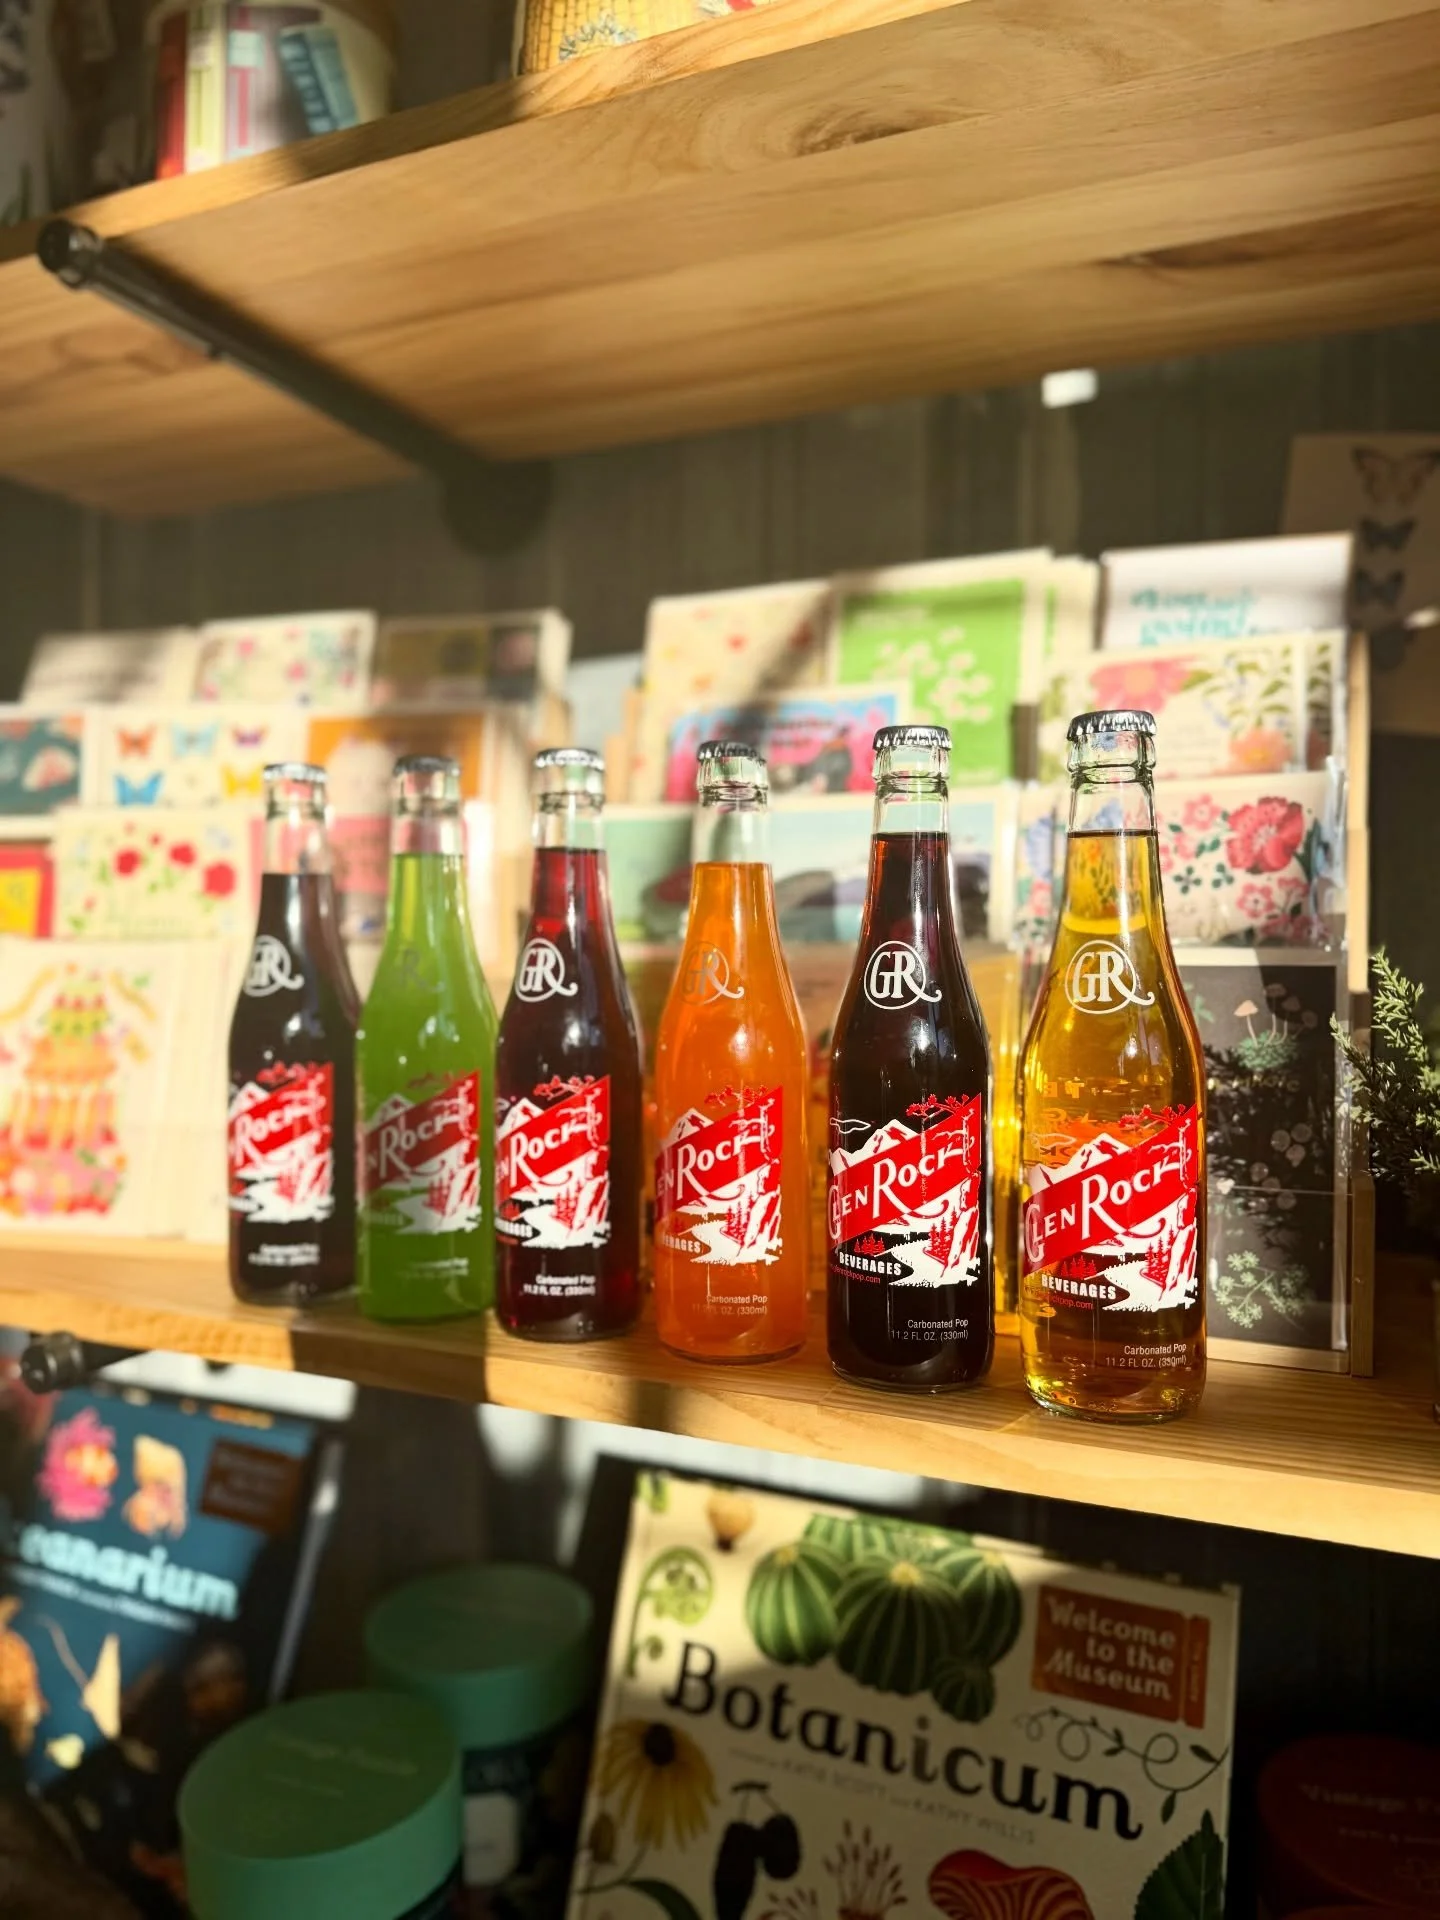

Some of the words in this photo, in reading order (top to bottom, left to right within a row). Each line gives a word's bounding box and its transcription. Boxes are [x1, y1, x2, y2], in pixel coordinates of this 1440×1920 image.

[839, 1251, 902, 1276] BEVERAGES
[1041, 1273, 1117, 1300] BEVERAGES
[706, 1295, 751, 1304] Carbonated
[752, 1294, 768, 1304] Pop
[737, 1305, 768, 1317] (330ml)
[907, 1319, 953, 1329] Carbonated
[955, 1318, 969, 1328] Pop
[911, 1331, 922, 1341] FL
[940, 1329, 969, 1342] (330ml)
[1124, 1345, 1172, 1356] Carbonated
[1173, 1343, 1187, 1353] Pop
[1128, 1358, 1139, 1367] FL
[1141, 1358, 1156, 1368] OZ.
[1047, 1596, 1177, 1649] Welcome
[1085, 1636, 1116, 1663] to
[1126, 1644, 1175, 1676] the
[1043, 1648, 1173, 1701] Museum
[662, 1641, 1143, 1841] Botanicum
